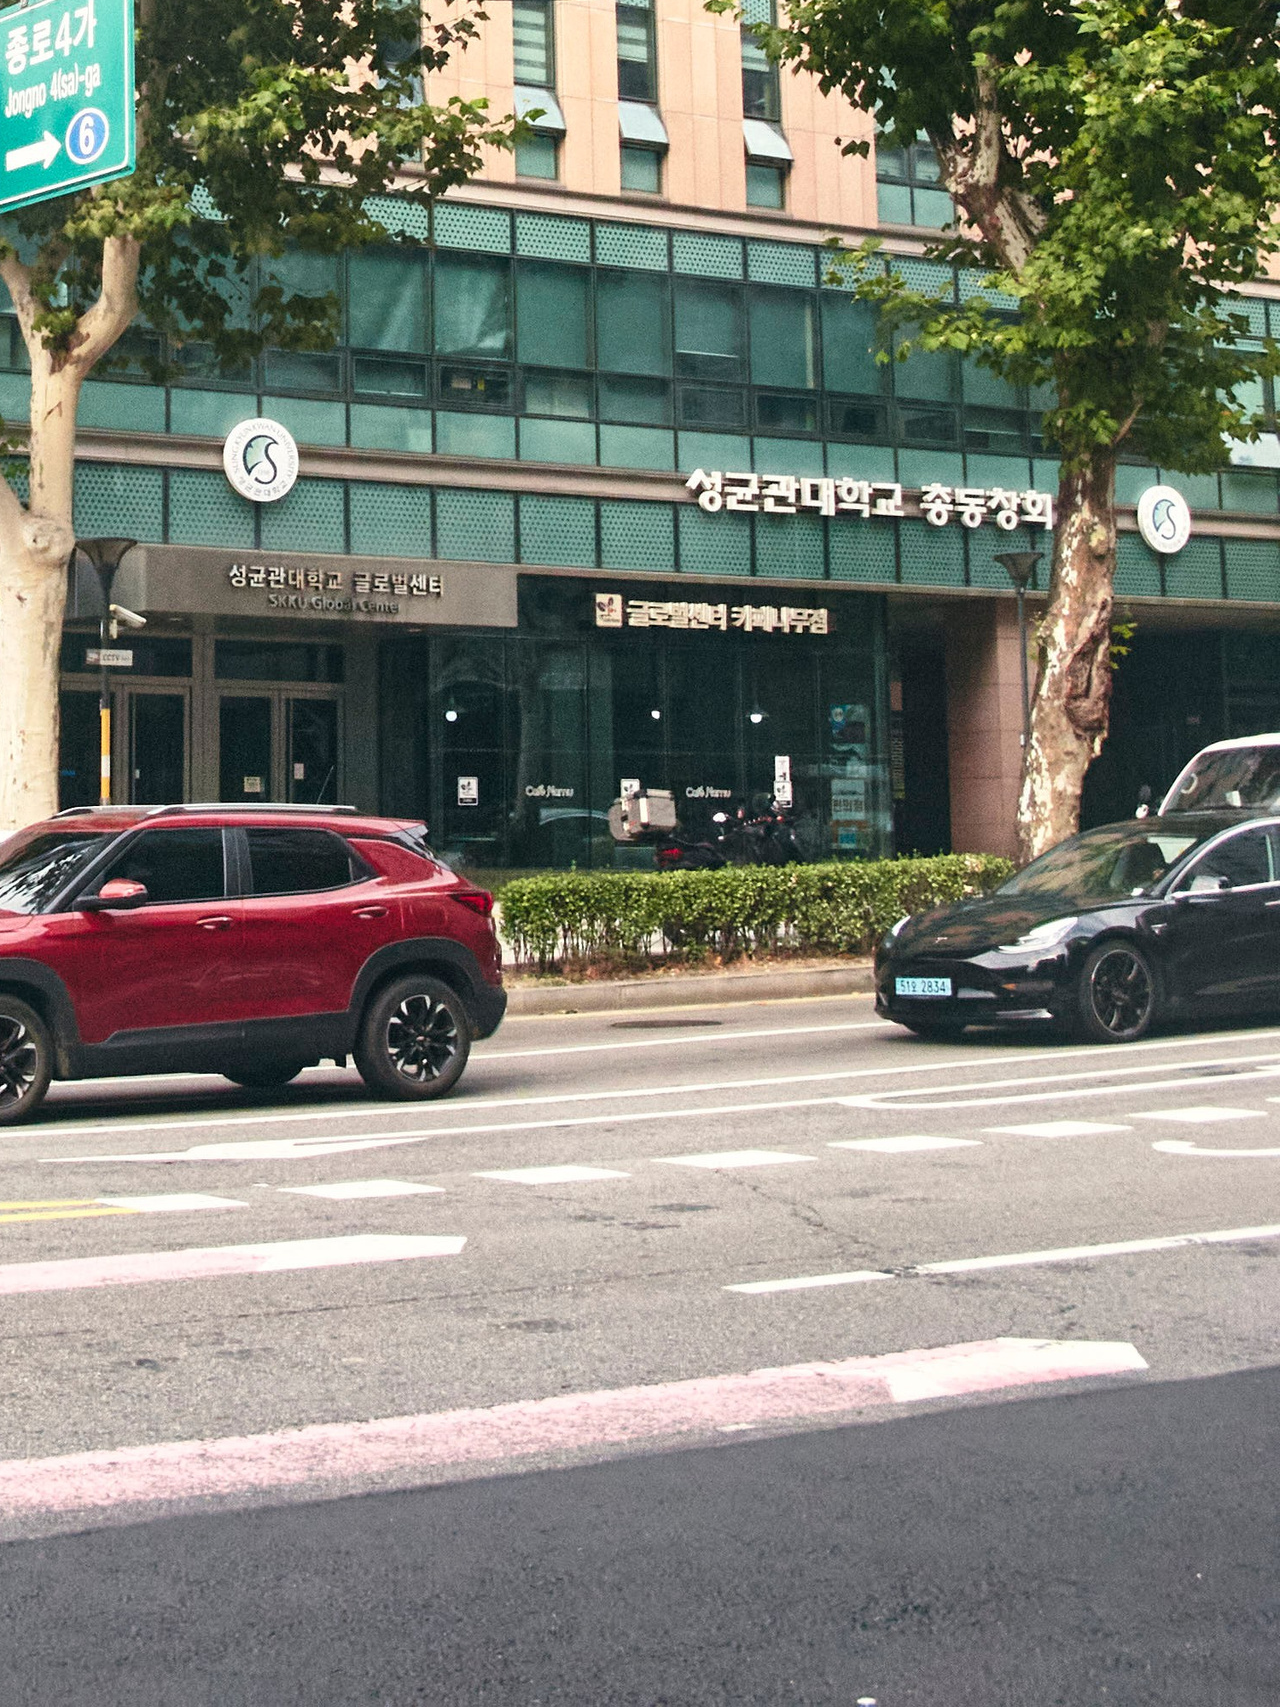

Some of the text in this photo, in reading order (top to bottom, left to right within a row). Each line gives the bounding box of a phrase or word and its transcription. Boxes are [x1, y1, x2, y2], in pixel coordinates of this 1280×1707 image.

[4, 62, 101, 119] Jongno 4(sa)-ga
[79, 115, 95, 155] 6
[685, 467, 1053, 531] 성균관대학교 총동창회
[229, 564, 444, 597] 성균관대학교 글로벌센터
[268, 593, 401, 614] SKKU Global Center
[626, 600, 828, 635] 글로벌센터 카페나무점
